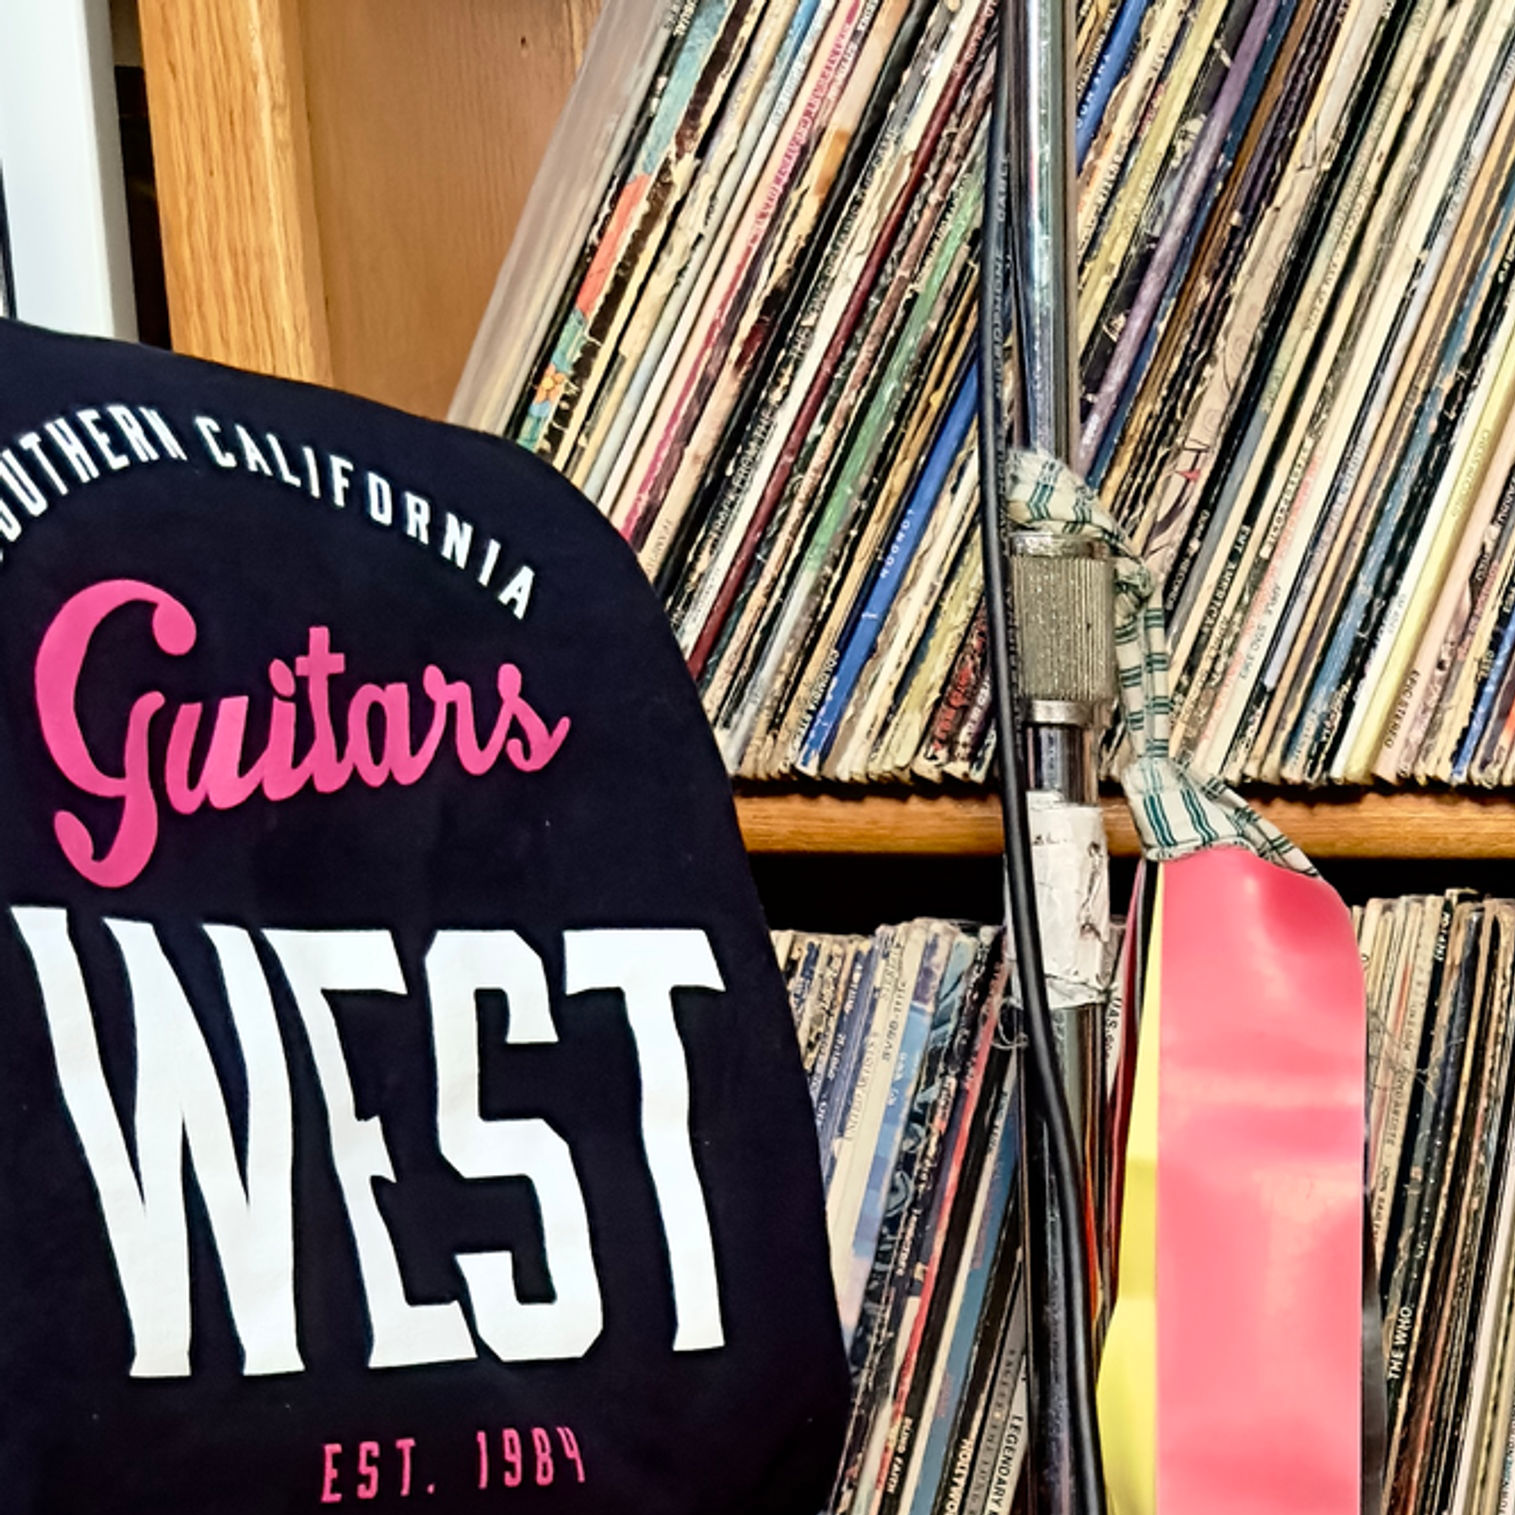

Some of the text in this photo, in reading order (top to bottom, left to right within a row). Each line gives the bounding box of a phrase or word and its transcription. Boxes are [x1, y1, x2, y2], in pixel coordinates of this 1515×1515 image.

[0, 405, 536, 620] OUTHERN CALIFORNIA
[34, 579, 571, 887] Guitars
[10, 905, 726, 1378] WEST
[1386, 1305, 1412, 1380] THE WHO
[320, 1426, 586, 1503] EST. 1984
[986, 1413, 1023, 1507] LEGENDARY
